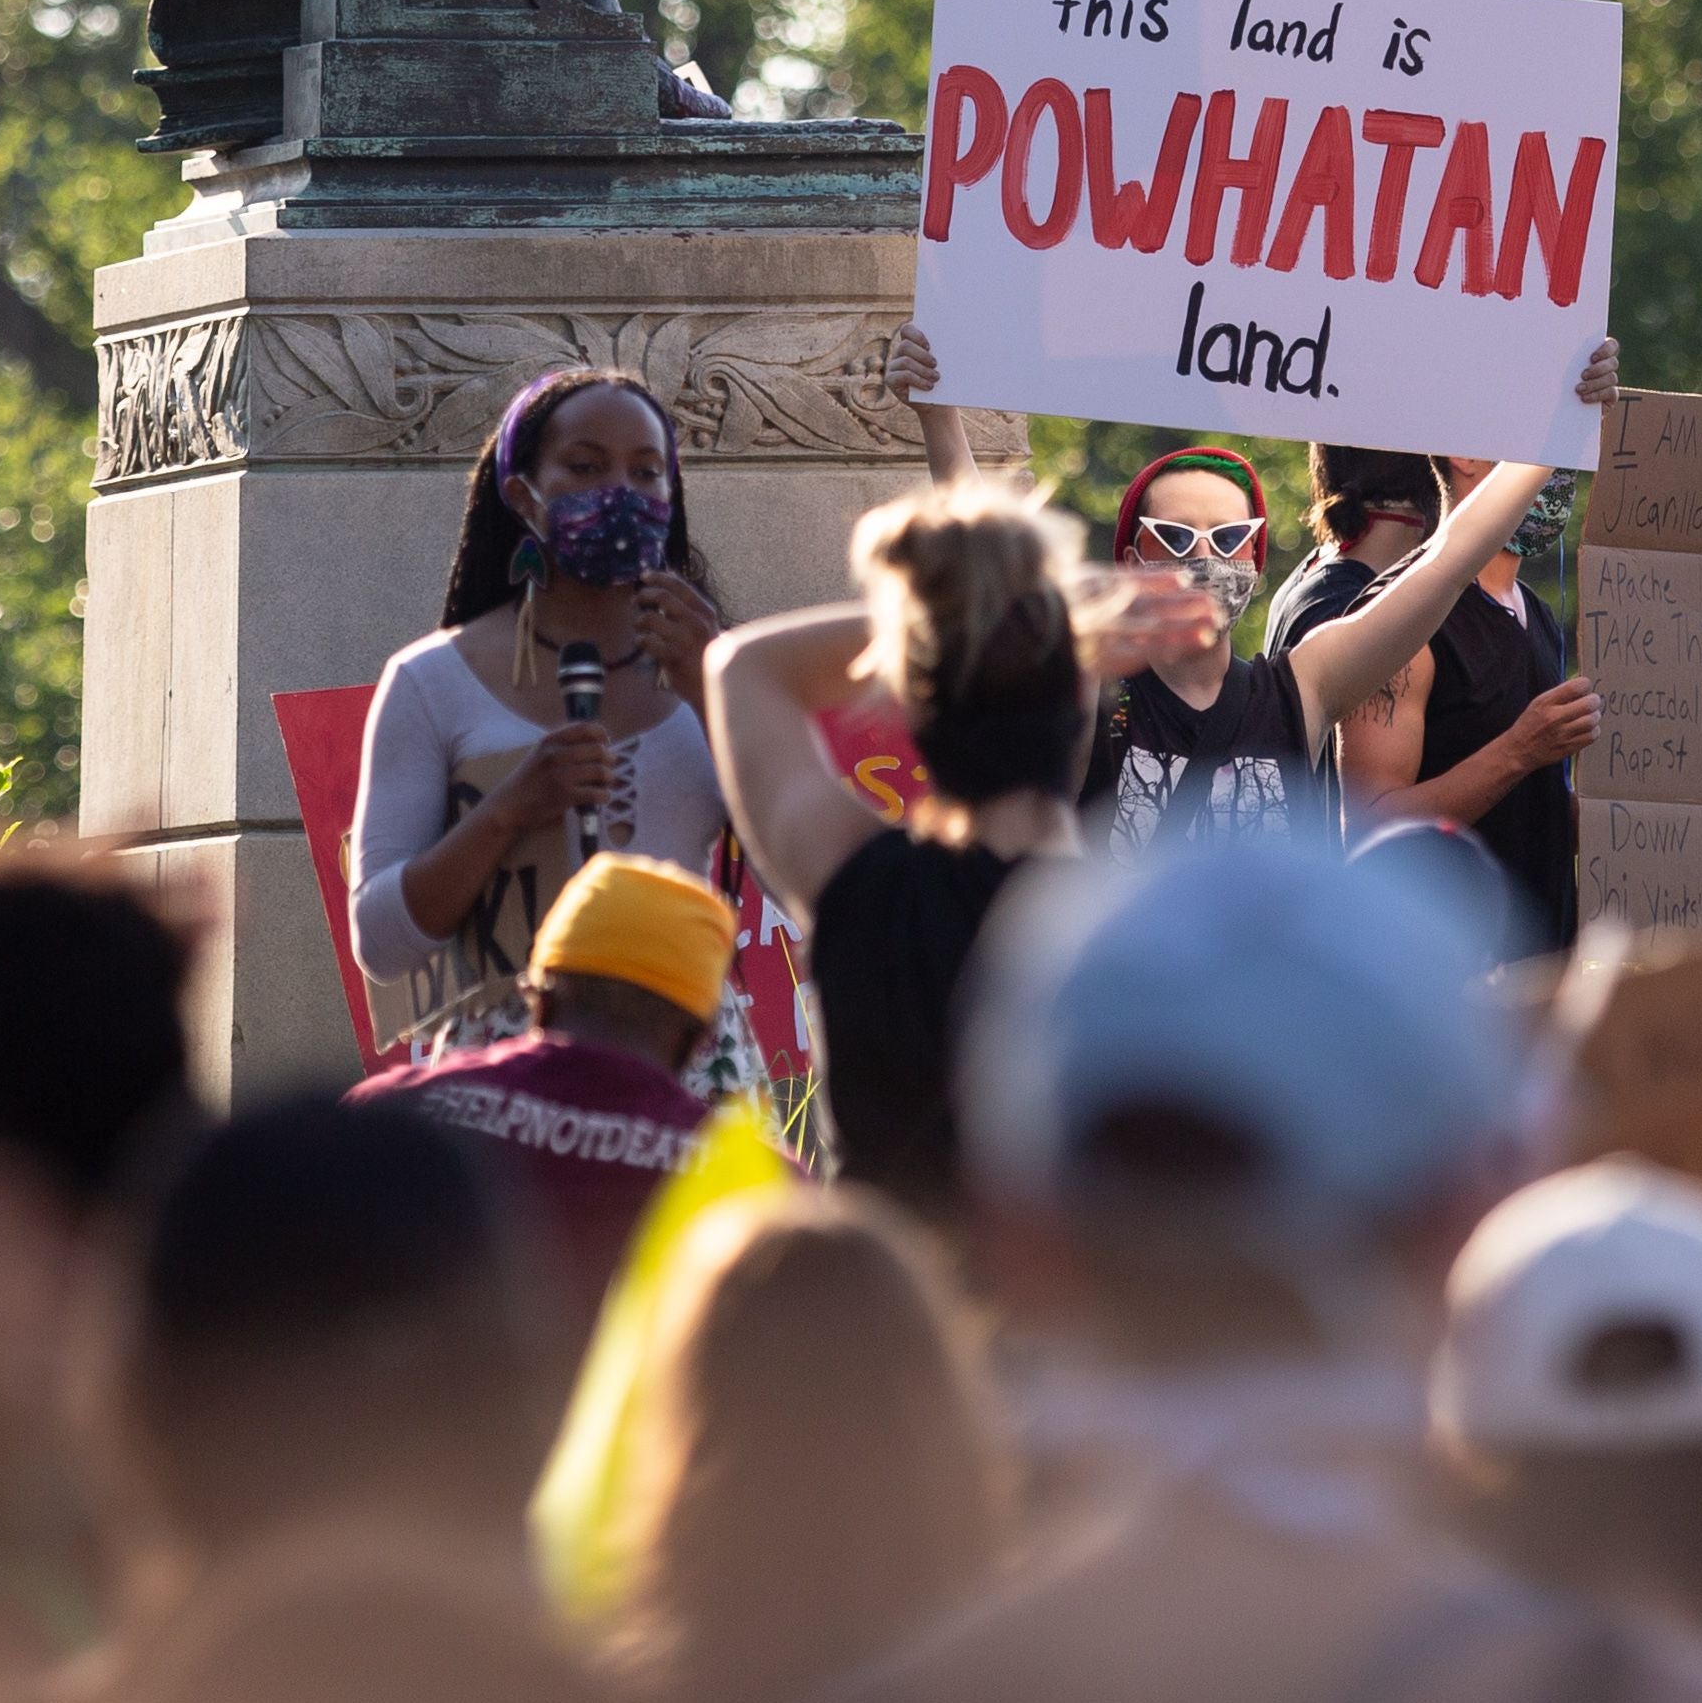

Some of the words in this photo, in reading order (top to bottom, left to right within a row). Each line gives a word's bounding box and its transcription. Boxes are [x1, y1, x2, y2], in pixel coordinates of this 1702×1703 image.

[1383, 18, 1431, 76] is
[923, 65, 1605, 307] POWHATAN
[1177, 282, 1339, 399] land.
[1613, 396, 1642, 456] I
[1655, 409, 1697, 458] AM
